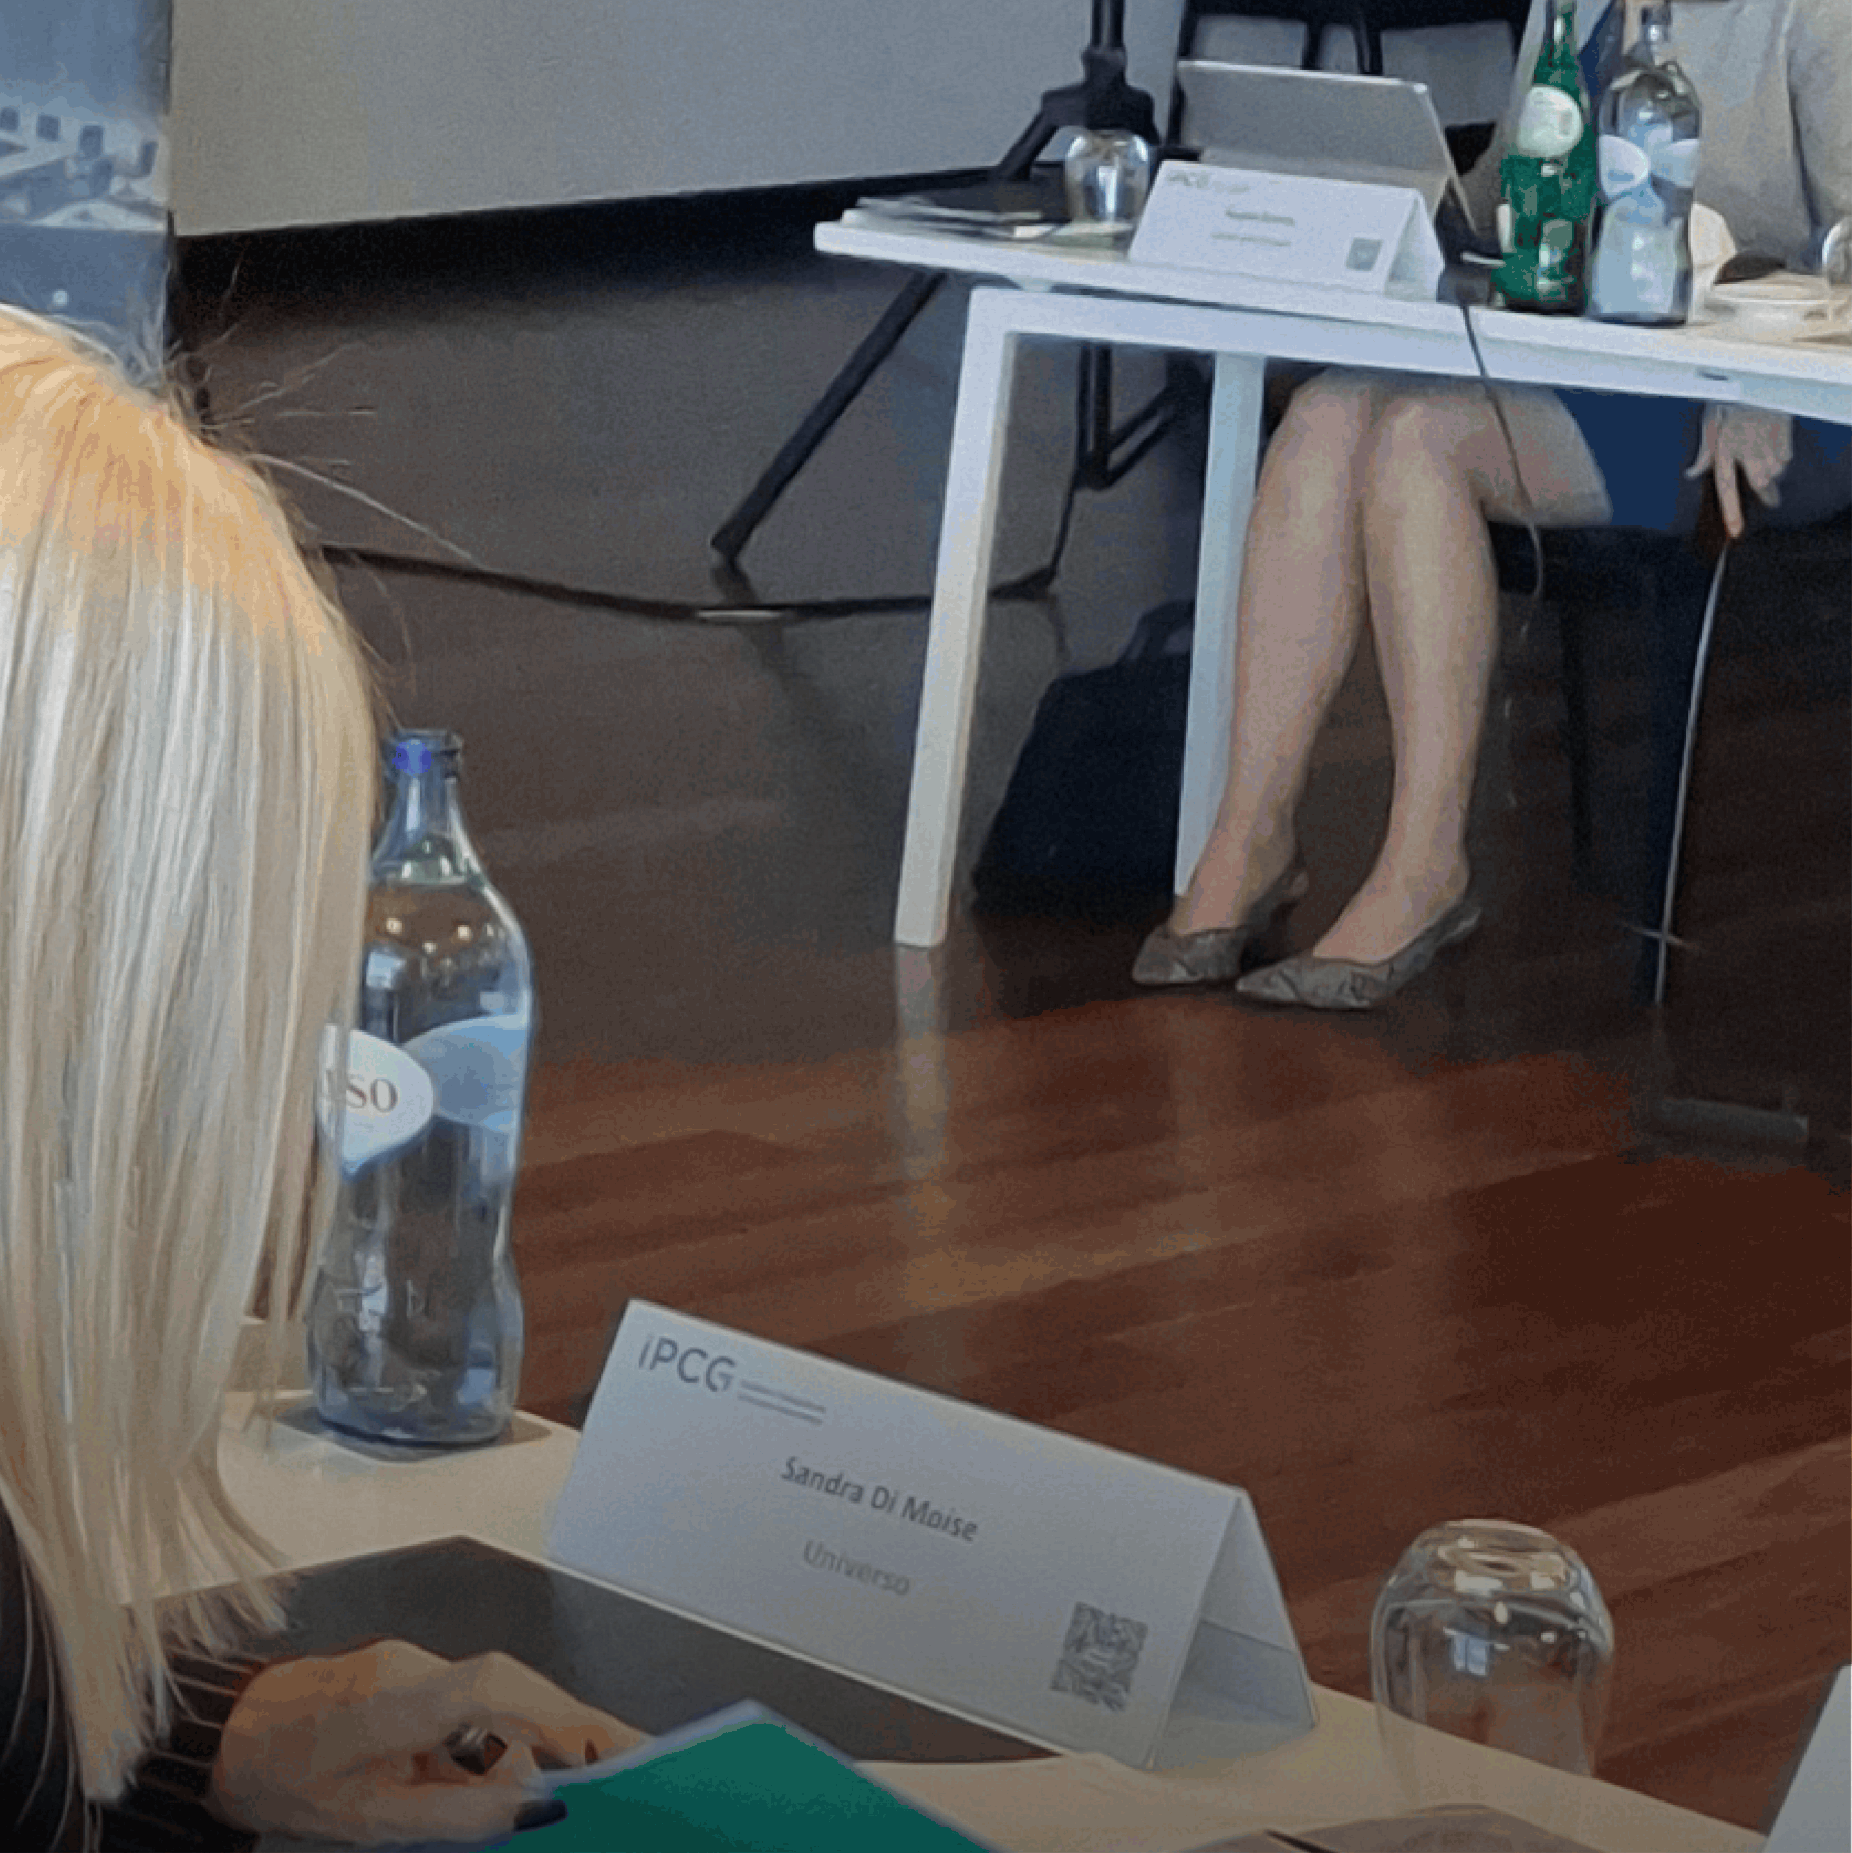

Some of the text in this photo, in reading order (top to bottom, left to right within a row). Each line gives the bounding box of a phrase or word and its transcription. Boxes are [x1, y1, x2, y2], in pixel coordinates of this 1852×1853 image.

[638, 1334, 736, 1393] iPCG
[781, 1455, 979, 1542] Sandra Di Moise
[802, 1539, 911, 1597] Universo
